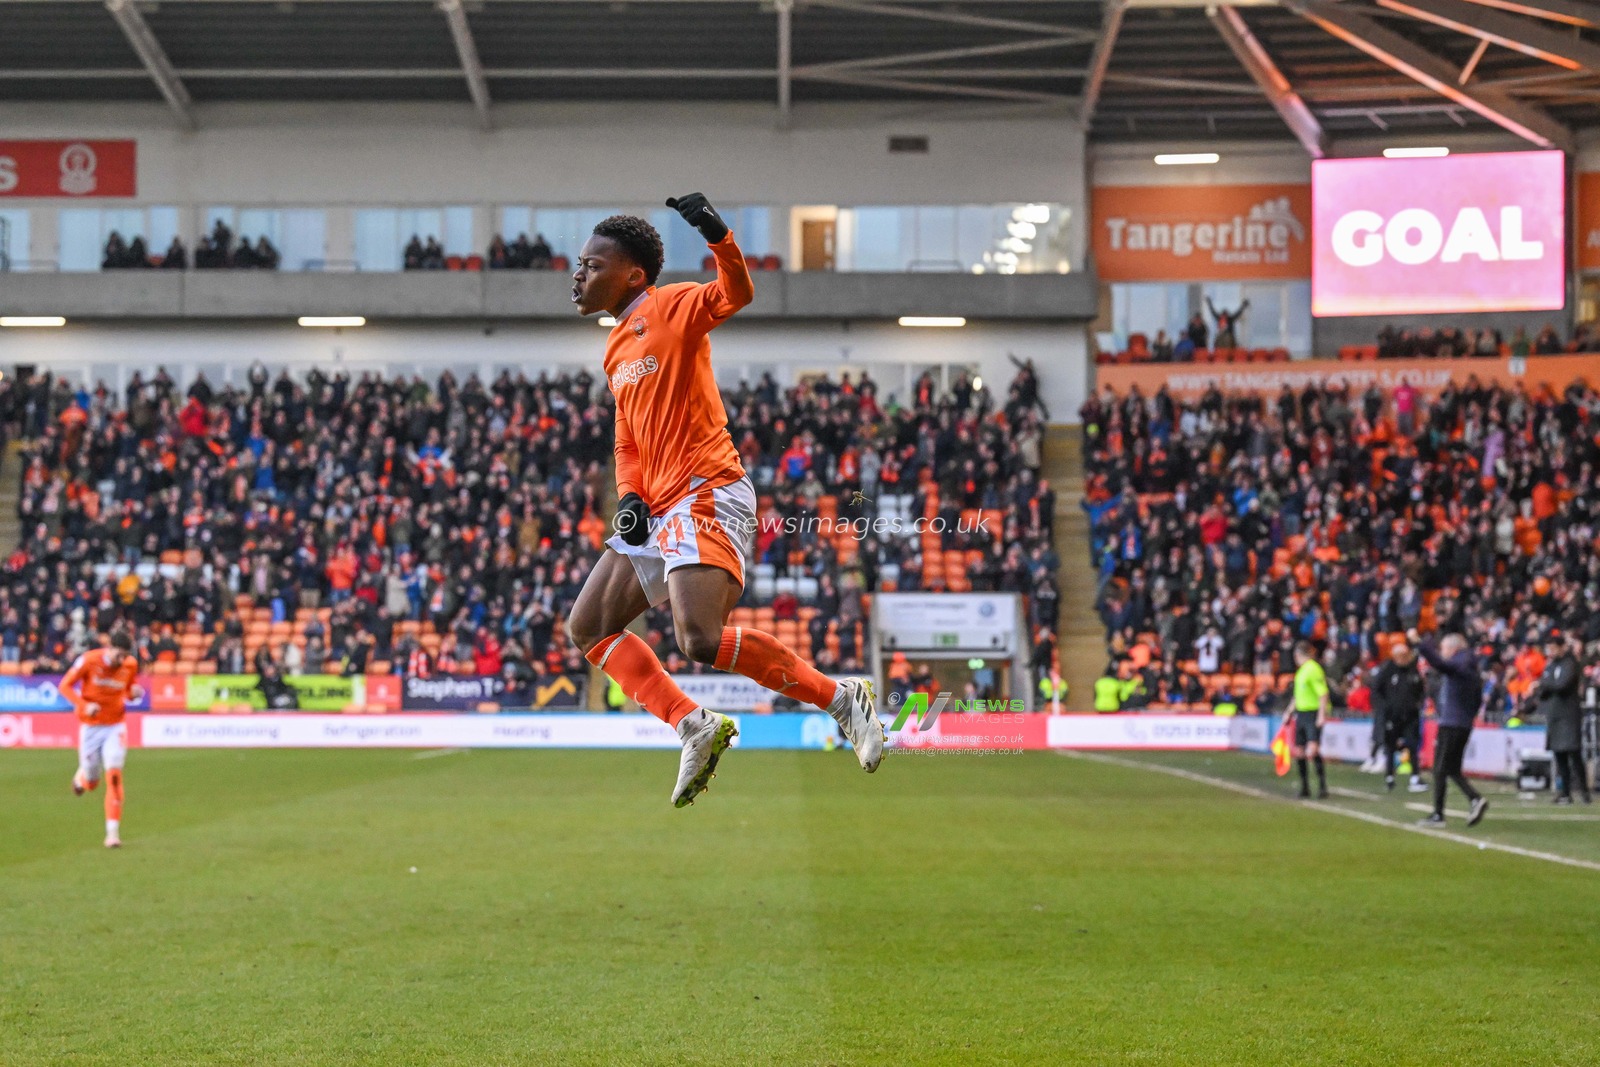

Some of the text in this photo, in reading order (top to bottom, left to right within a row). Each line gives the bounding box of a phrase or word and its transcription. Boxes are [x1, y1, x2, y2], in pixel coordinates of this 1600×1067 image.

[1105, 215, 1290, 257] Tangerine
[1331, 205, 1545, 267] GOAL
[407, 676, 482, 702] Stephen
